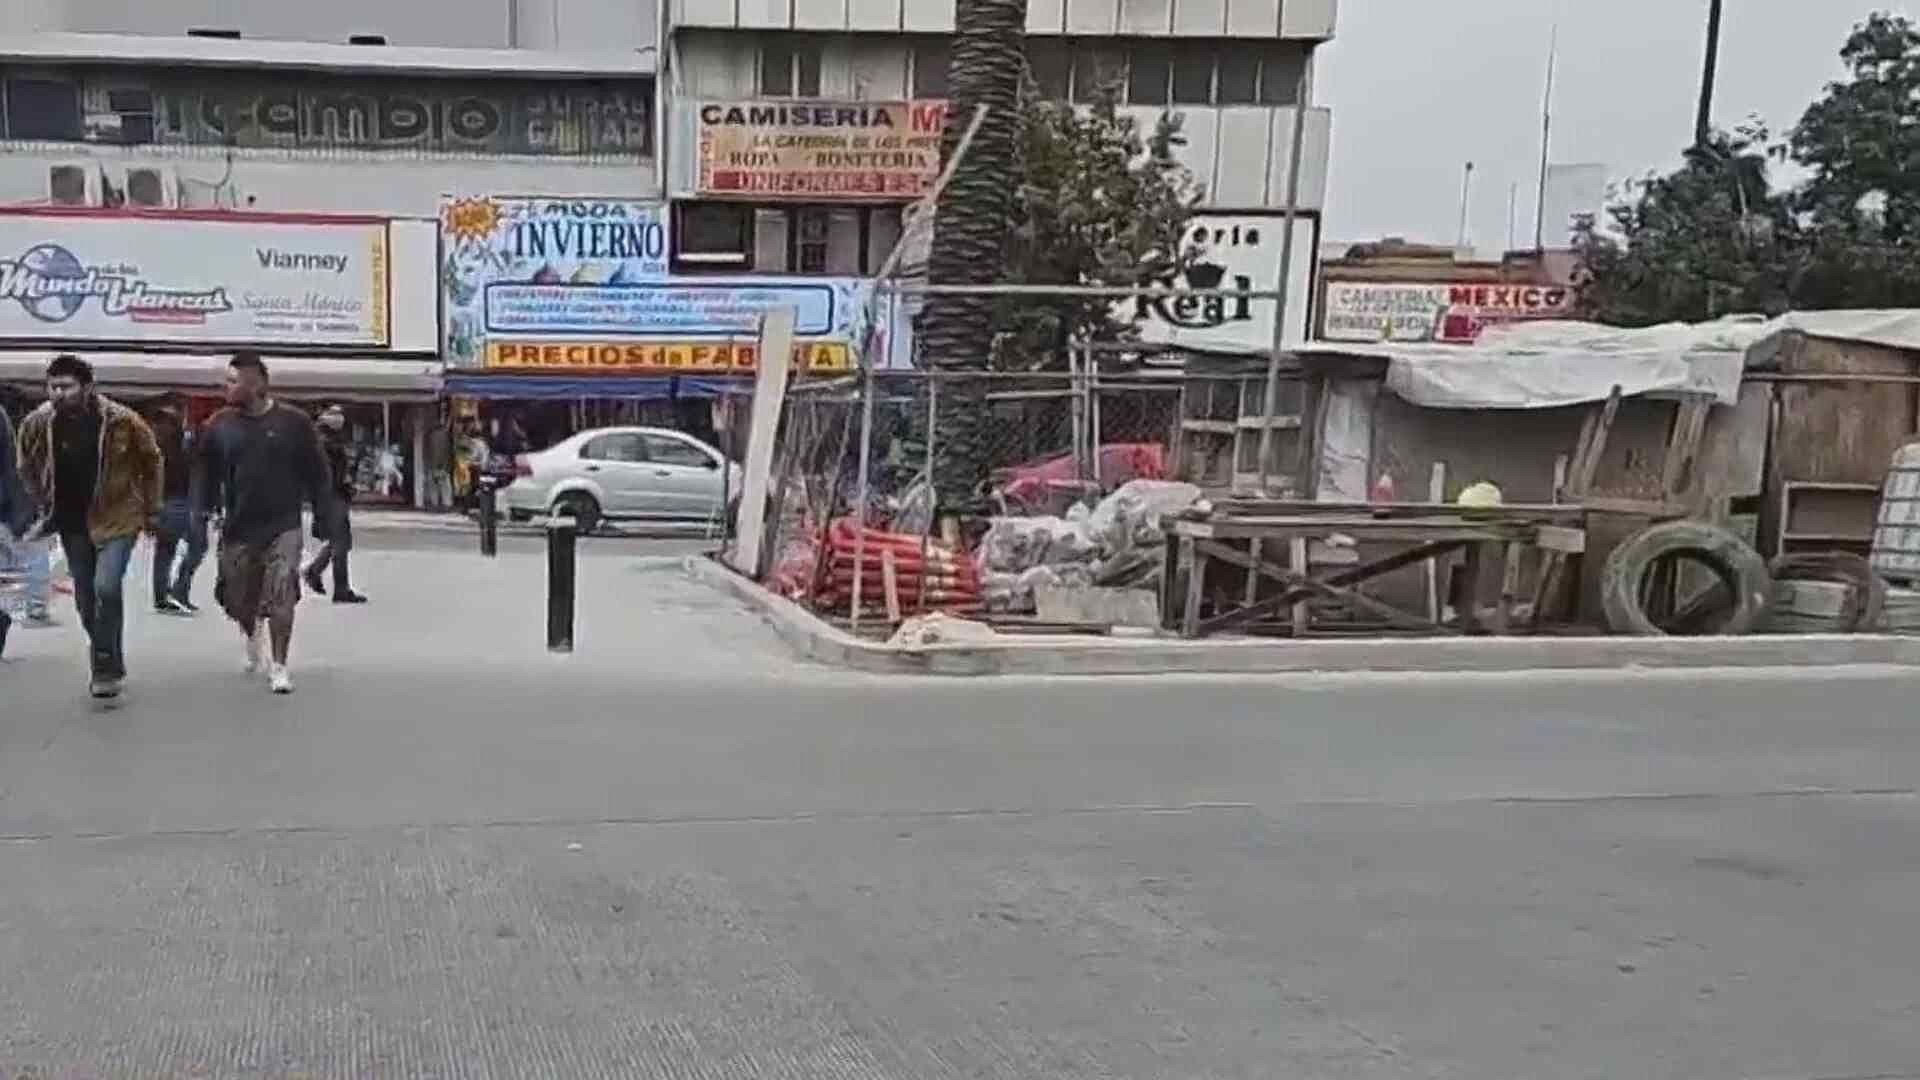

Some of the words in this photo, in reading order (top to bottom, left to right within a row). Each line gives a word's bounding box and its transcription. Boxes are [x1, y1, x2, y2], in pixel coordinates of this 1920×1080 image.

[701, 104, 894, 127] CAMISERIA
[729, 151, 779, 167] ROPA
[546, 203, 627, 218] MODA
[511, 221, 665, 260] INVIERNO
[256, 248, 348, 273] Vianney
[1449, 287, 1566, 308] MEXICO
[498, 344, 644, 366] PRECIOS
